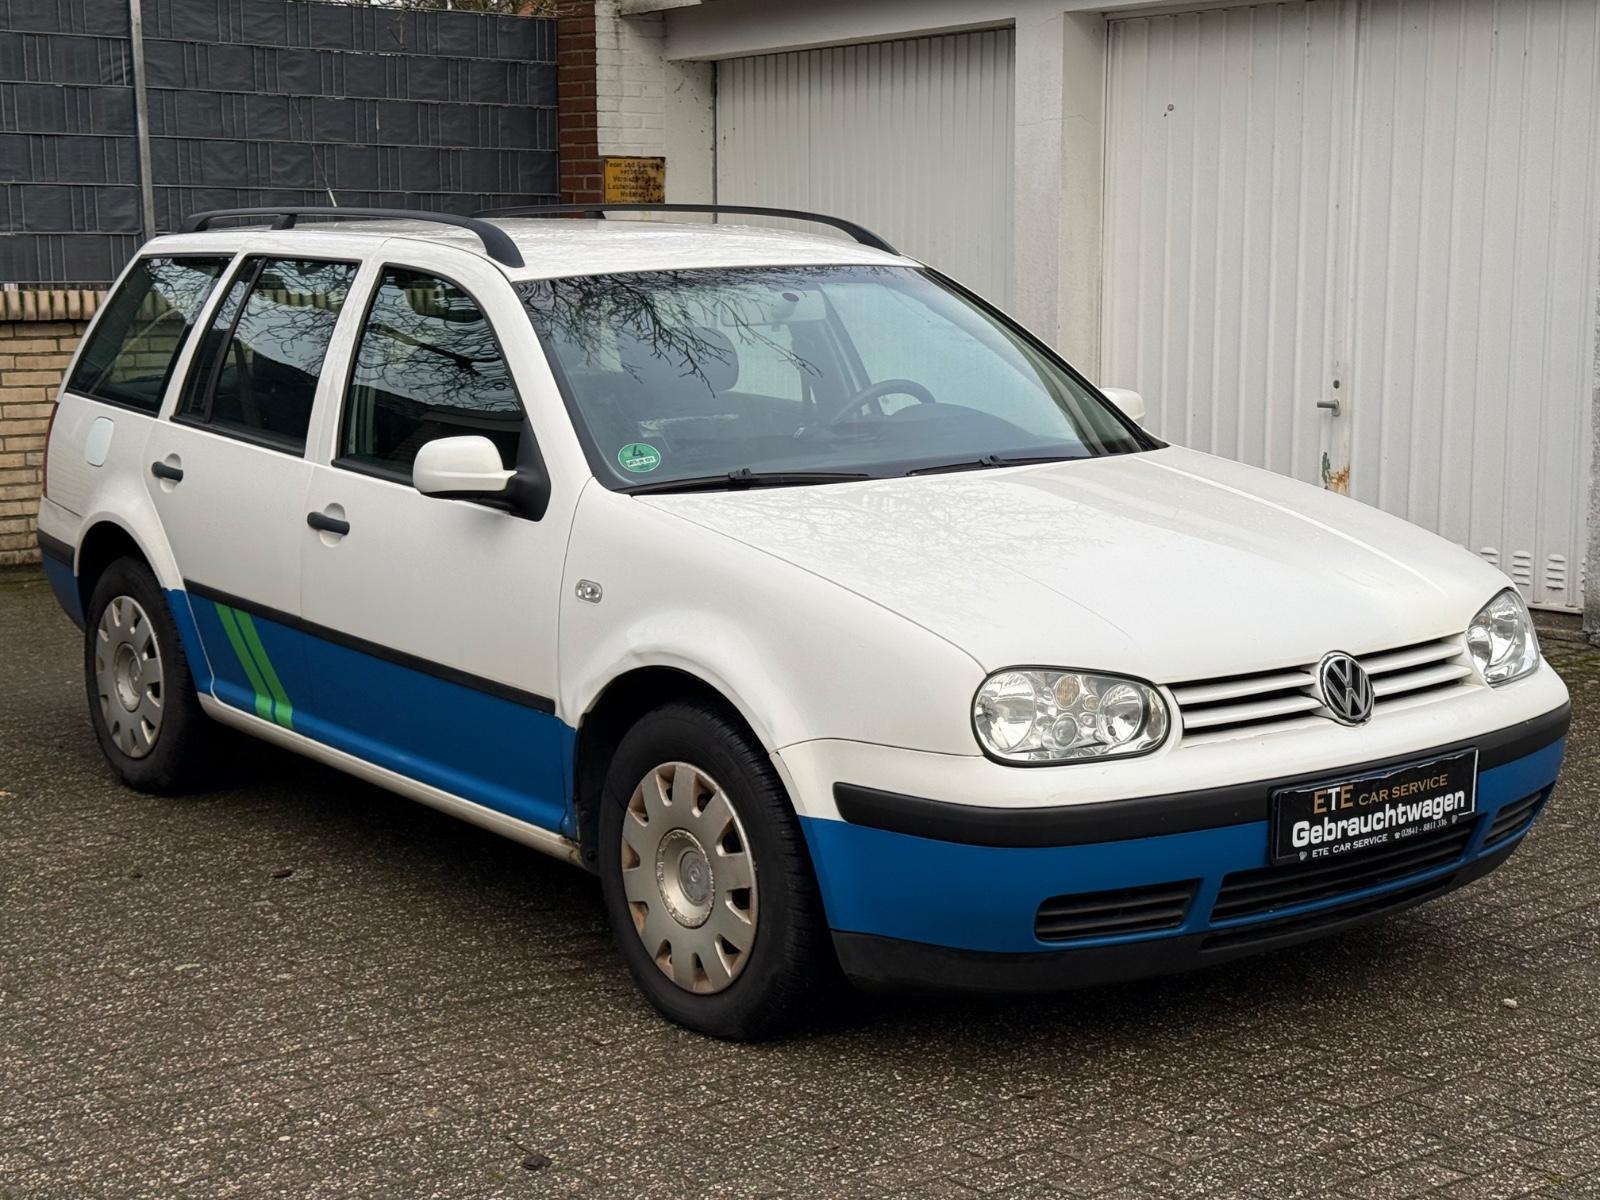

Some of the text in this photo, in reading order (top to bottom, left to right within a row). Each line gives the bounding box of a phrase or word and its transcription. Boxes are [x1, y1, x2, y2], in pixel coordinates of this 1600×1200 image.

[632, 445, 644, 457] 4
[1323, 656, 1371, 720] VW
[1313, 774, 1449, 814] ETE CAR SERVICE
[1292, 790, 1465, 848] Gebrauchtwagen
[1312, 847, 1330, 858] ETE
[1332, 843, 1352, 853] CAR
[1352, 834, 1388, 849] SERVICE
